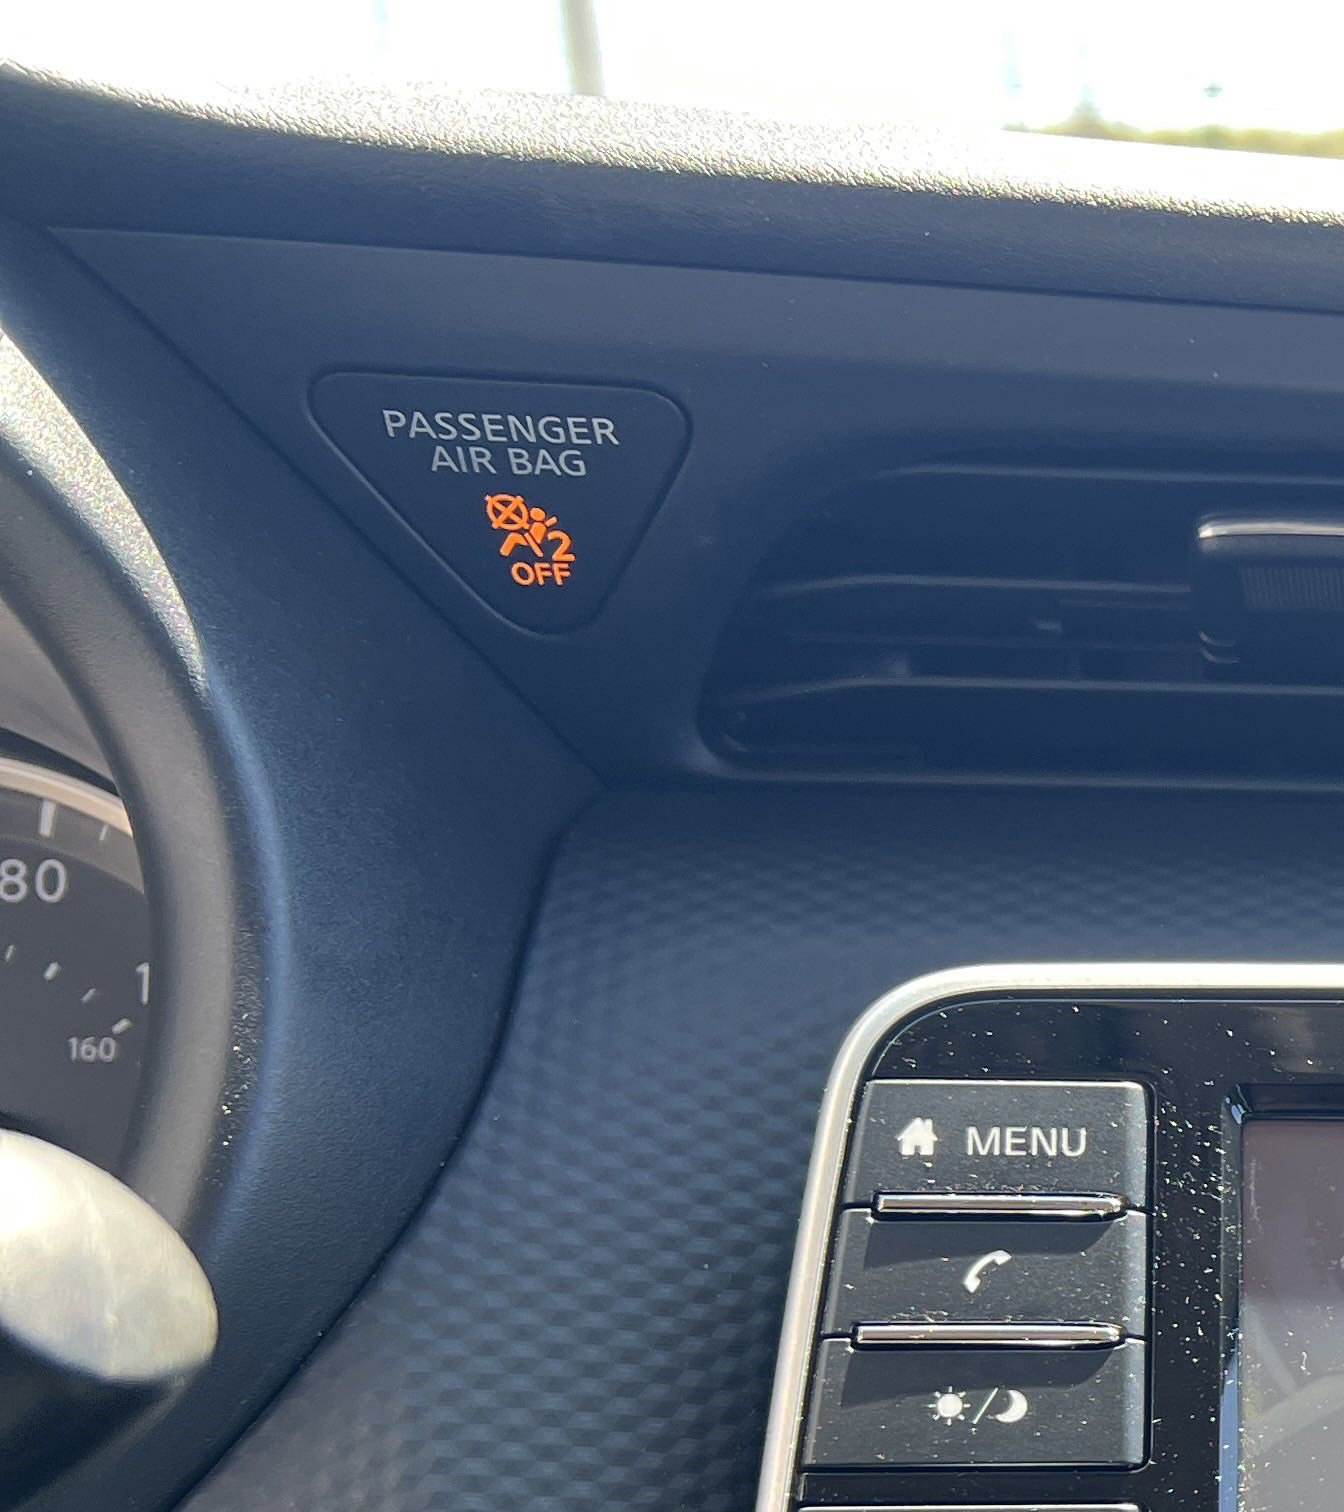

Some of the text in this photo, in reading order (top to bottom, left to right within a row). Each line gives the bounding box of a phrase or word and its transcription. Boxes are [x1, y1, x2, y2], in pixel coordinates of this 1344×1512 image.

[383, 410, 619, 445] PASSENGER
[431, 446, 586, 476] AIR BAG
[511, 562, 572, 586] OFF
[68, 1037, 117, 1062] 160
[966, 1126, 1087, 1157] MENU
